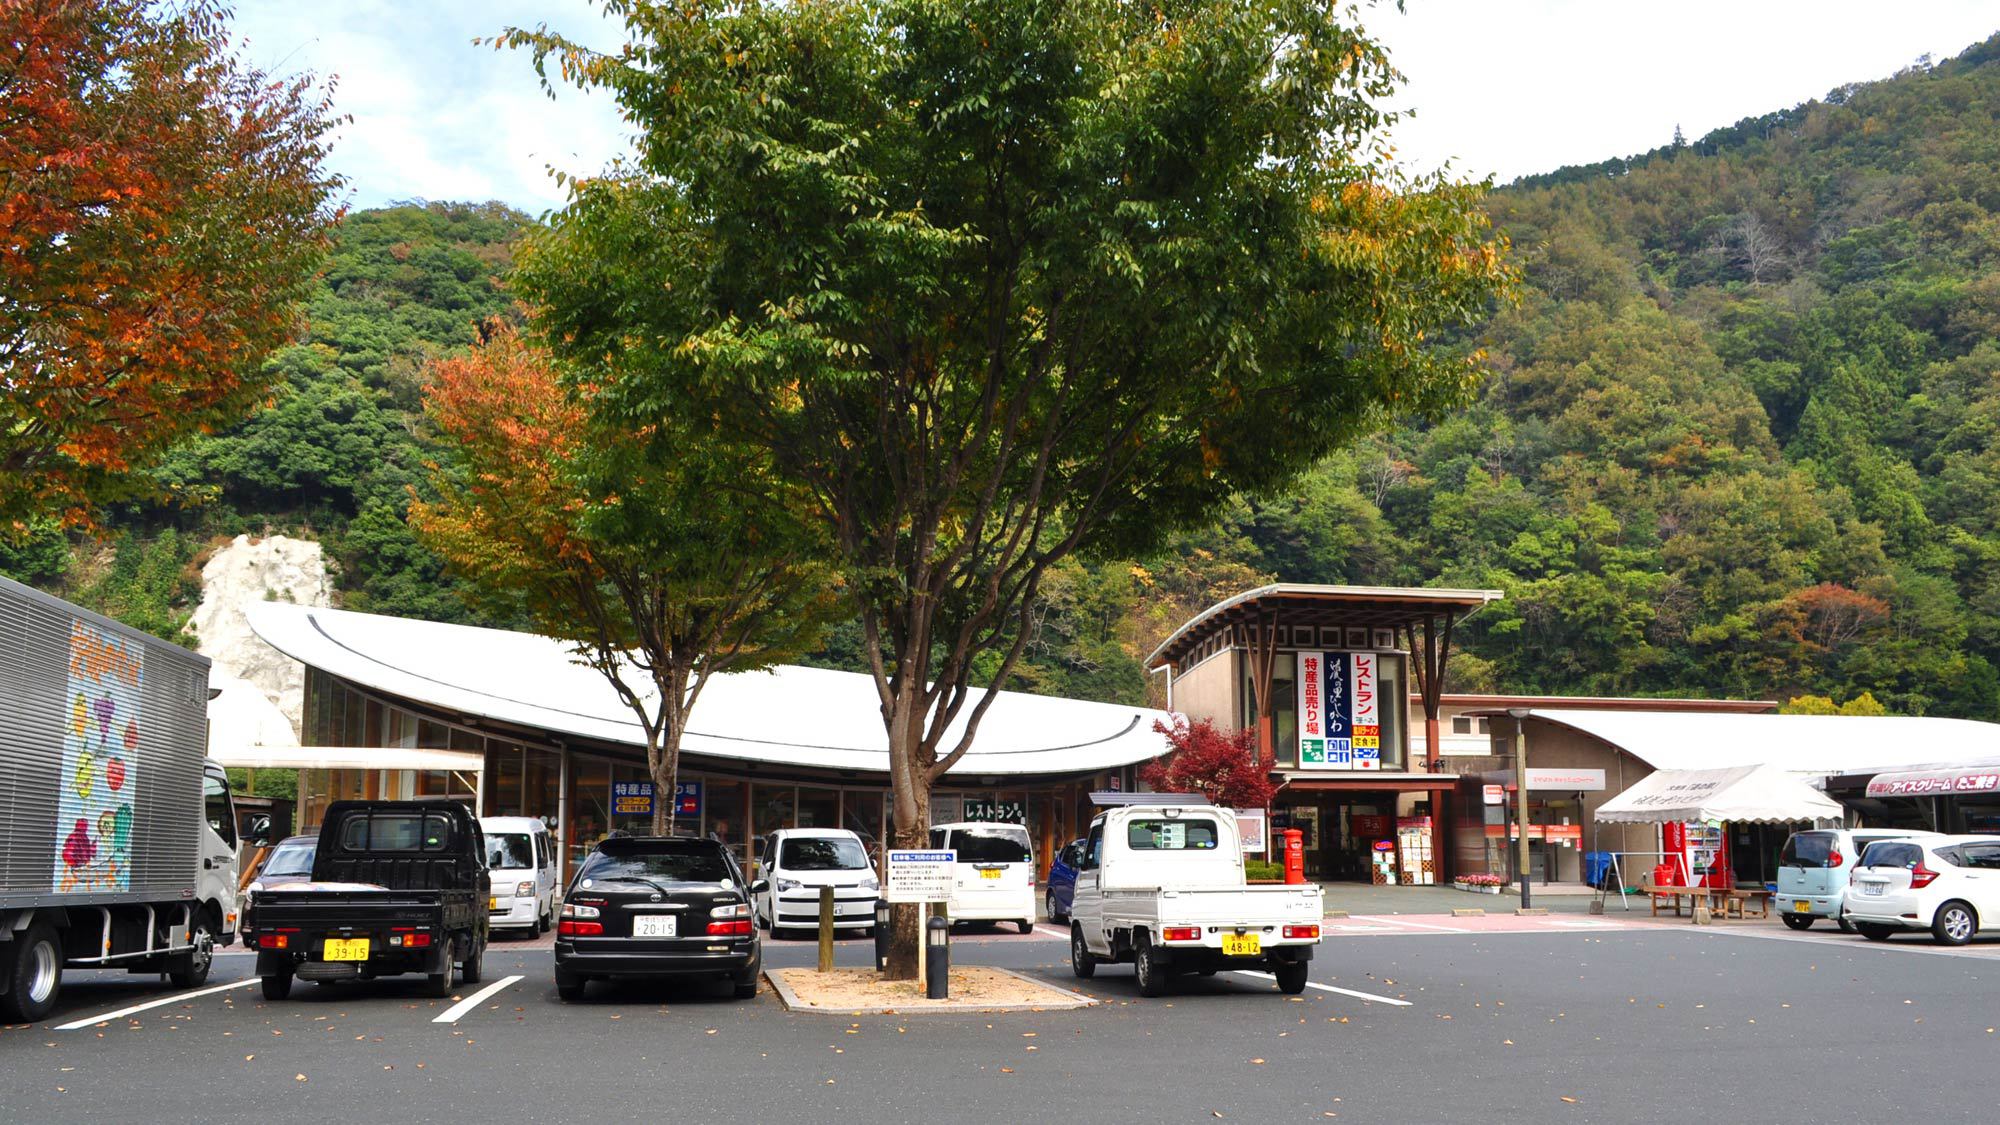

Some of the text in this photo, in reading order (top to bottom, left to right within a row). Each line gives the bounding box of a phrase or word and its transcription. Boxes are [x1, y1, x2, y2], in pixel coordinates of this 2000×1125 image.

[1356, 655, 1373, 715] レストラン
[1304, 657, 1319, 735] 特産品売り場
[1353, 749, 1378, 758] モーニング
[1956, 775, 1997, 789] たこ焼き
[966, 804, 1014, 819] レストラン
[643, 923, 674, 935] 20-15
[334, 947, 366, 959] 39-15
[1231, 942, 1258, 953] 48-12
